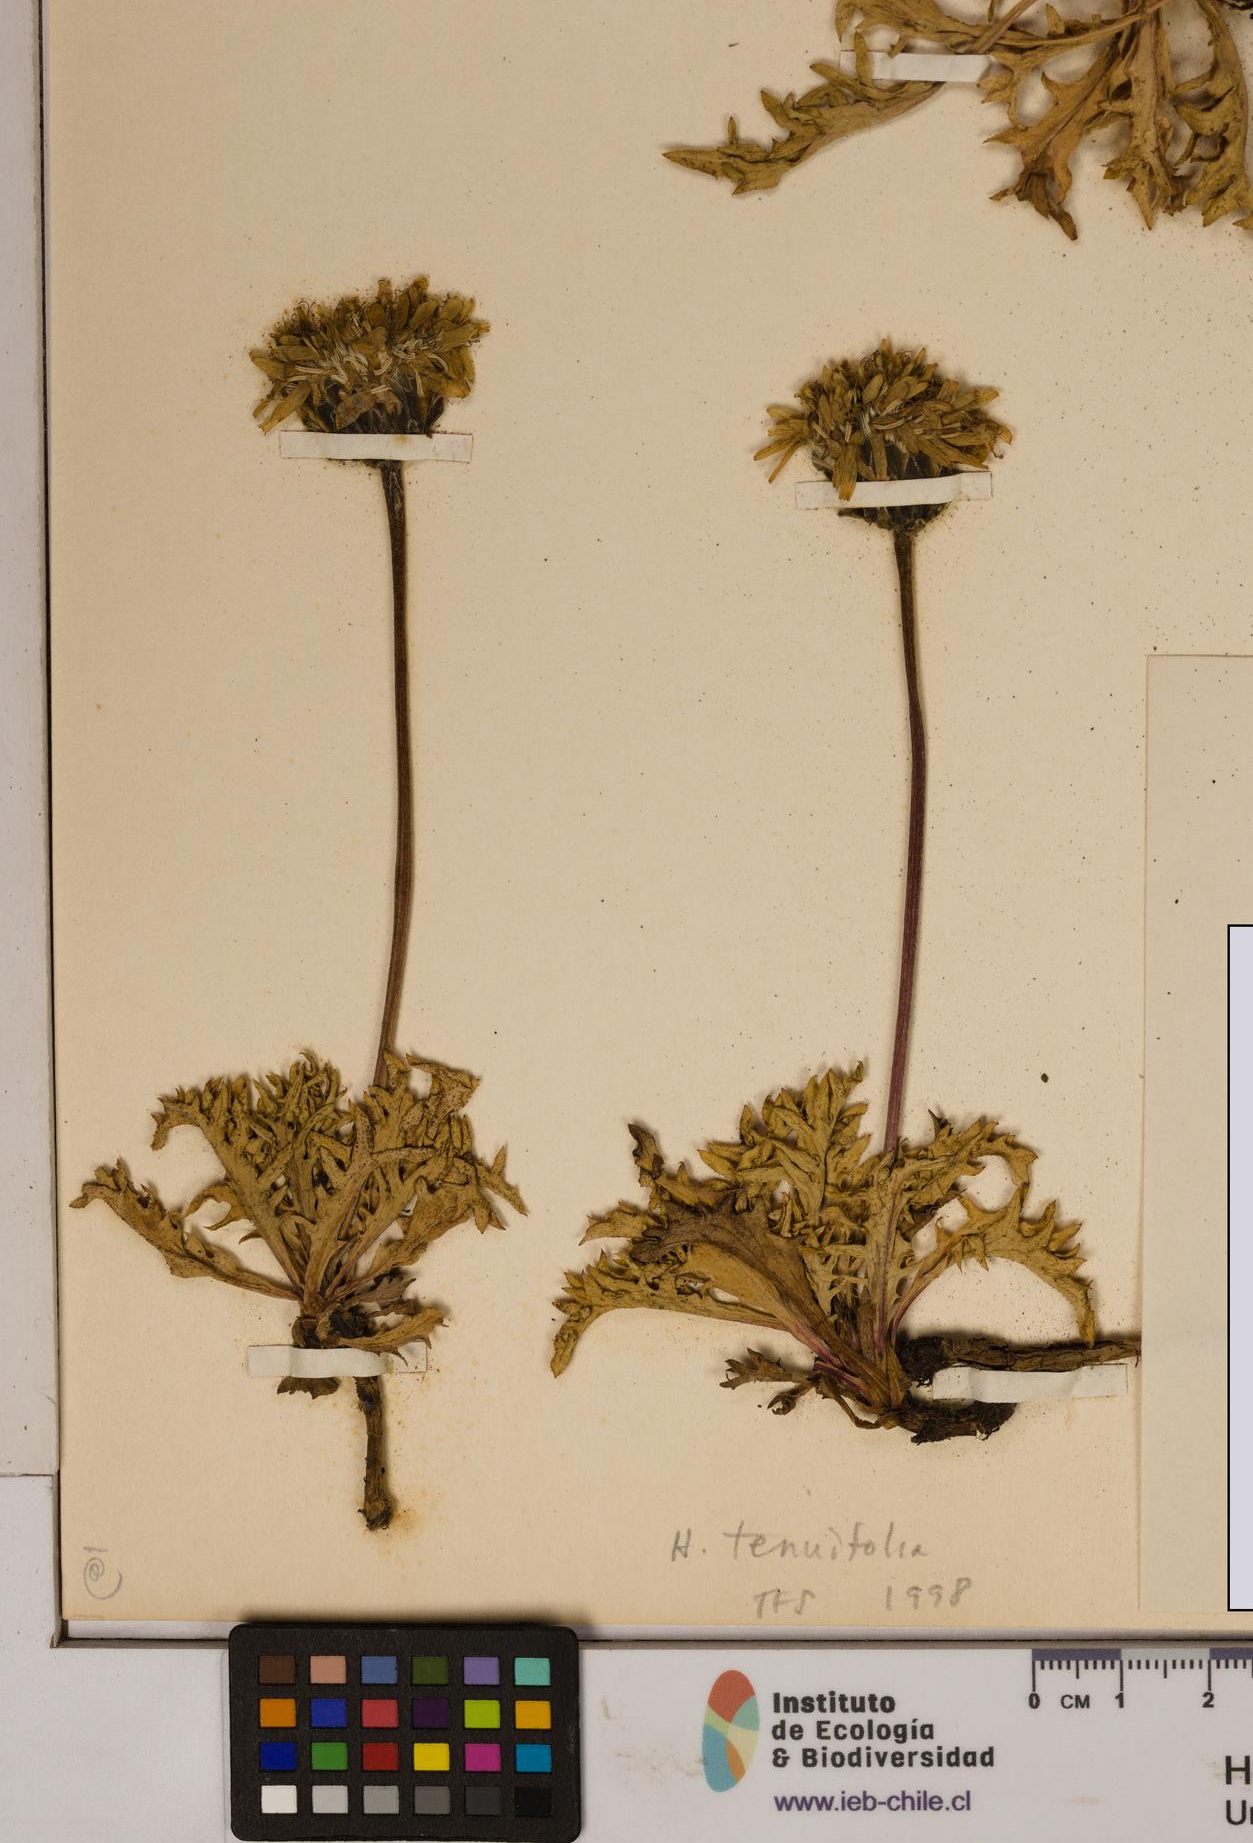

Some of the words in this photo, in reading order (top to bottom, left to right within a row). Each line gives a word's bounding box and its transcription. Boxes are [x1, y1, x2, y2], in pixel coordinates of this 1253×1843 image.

[670, 1528, 707, 1562] H.
[722, 1520, 929, 1562] tenuifolia
[885, 1577, 972, 1611] 1998
[772, 1691, 897, 1714] Instituto
[1028, 1693, 1041, 1710] 0
[1059, 1693, 1091, 1710] CM
[1115, 1694, 1125, 1709] 1
[1202, 1693, 1215, 1709] 2
[771, 1719, 805, 1741] de
[815, 1717, 935, 1745] Ecología
[772, 1747, 791, 1768] &
[801, 1744, 996, 1769] Biodiversidad
[773, 1790, 972, 1812] www.ieb-chile.cl
